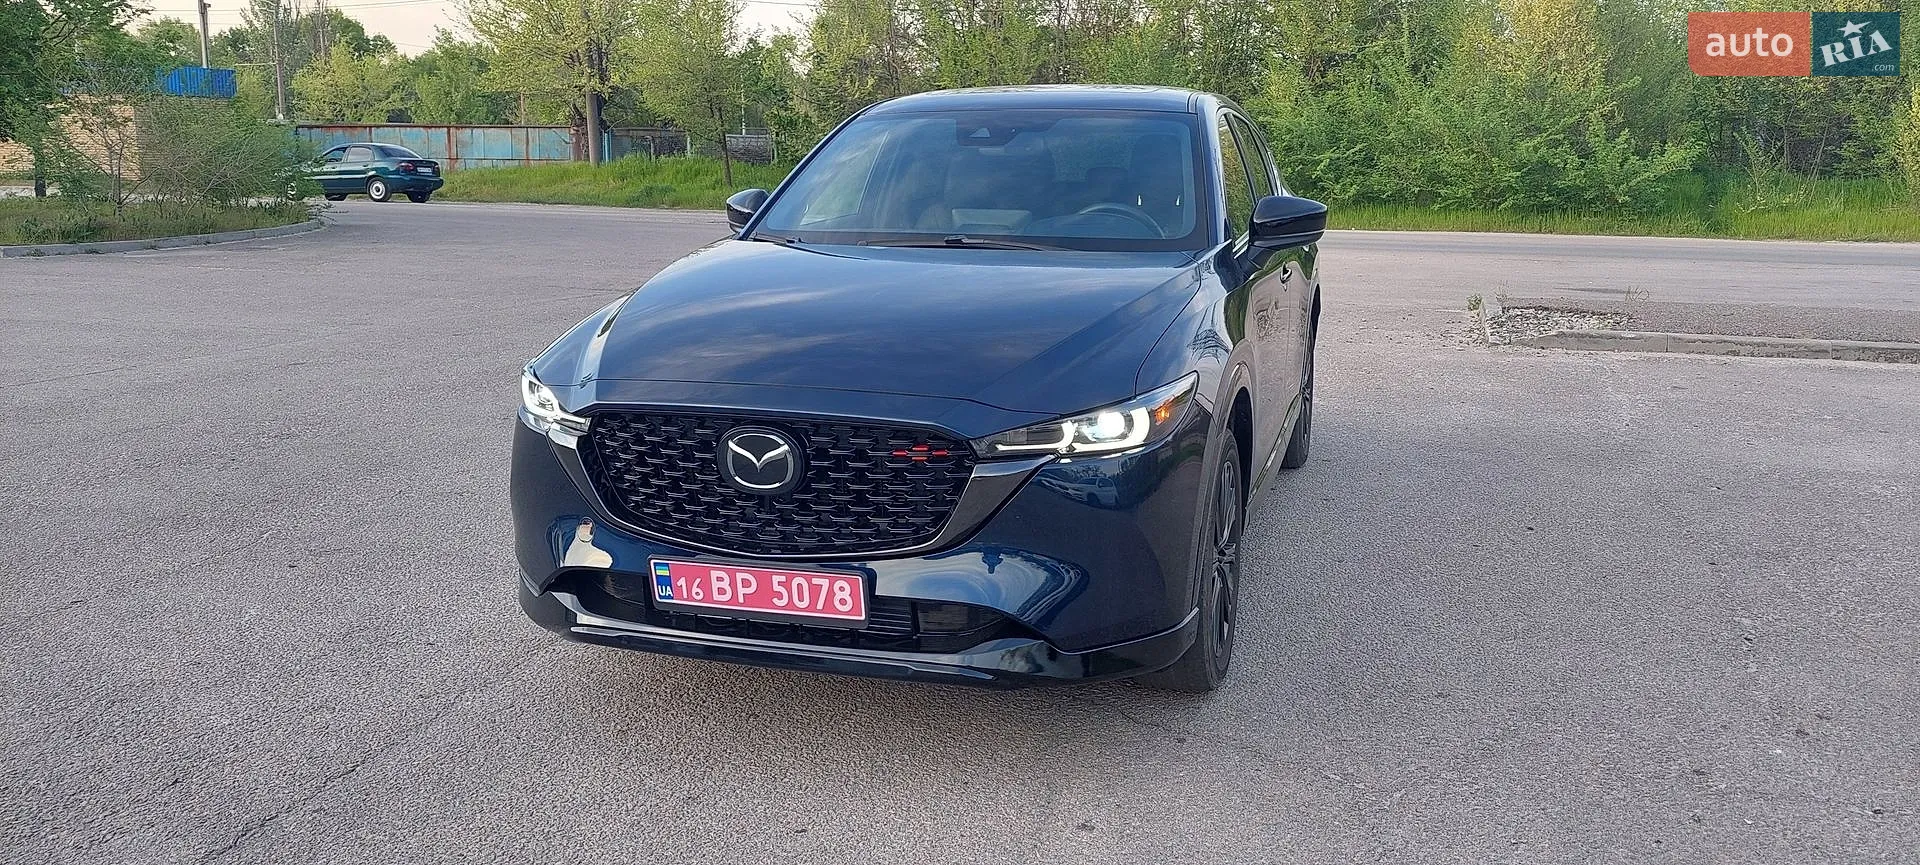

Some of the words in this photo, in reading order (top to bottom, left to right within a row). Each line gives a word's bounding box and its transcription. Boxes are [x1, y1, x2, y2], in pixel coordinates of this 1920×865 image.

[658, 584, 674, 597] UA
[676, 576, 705, 600] 16
[709, 569, 758, 604] BP
[771, 574, 854, 612] 5078
